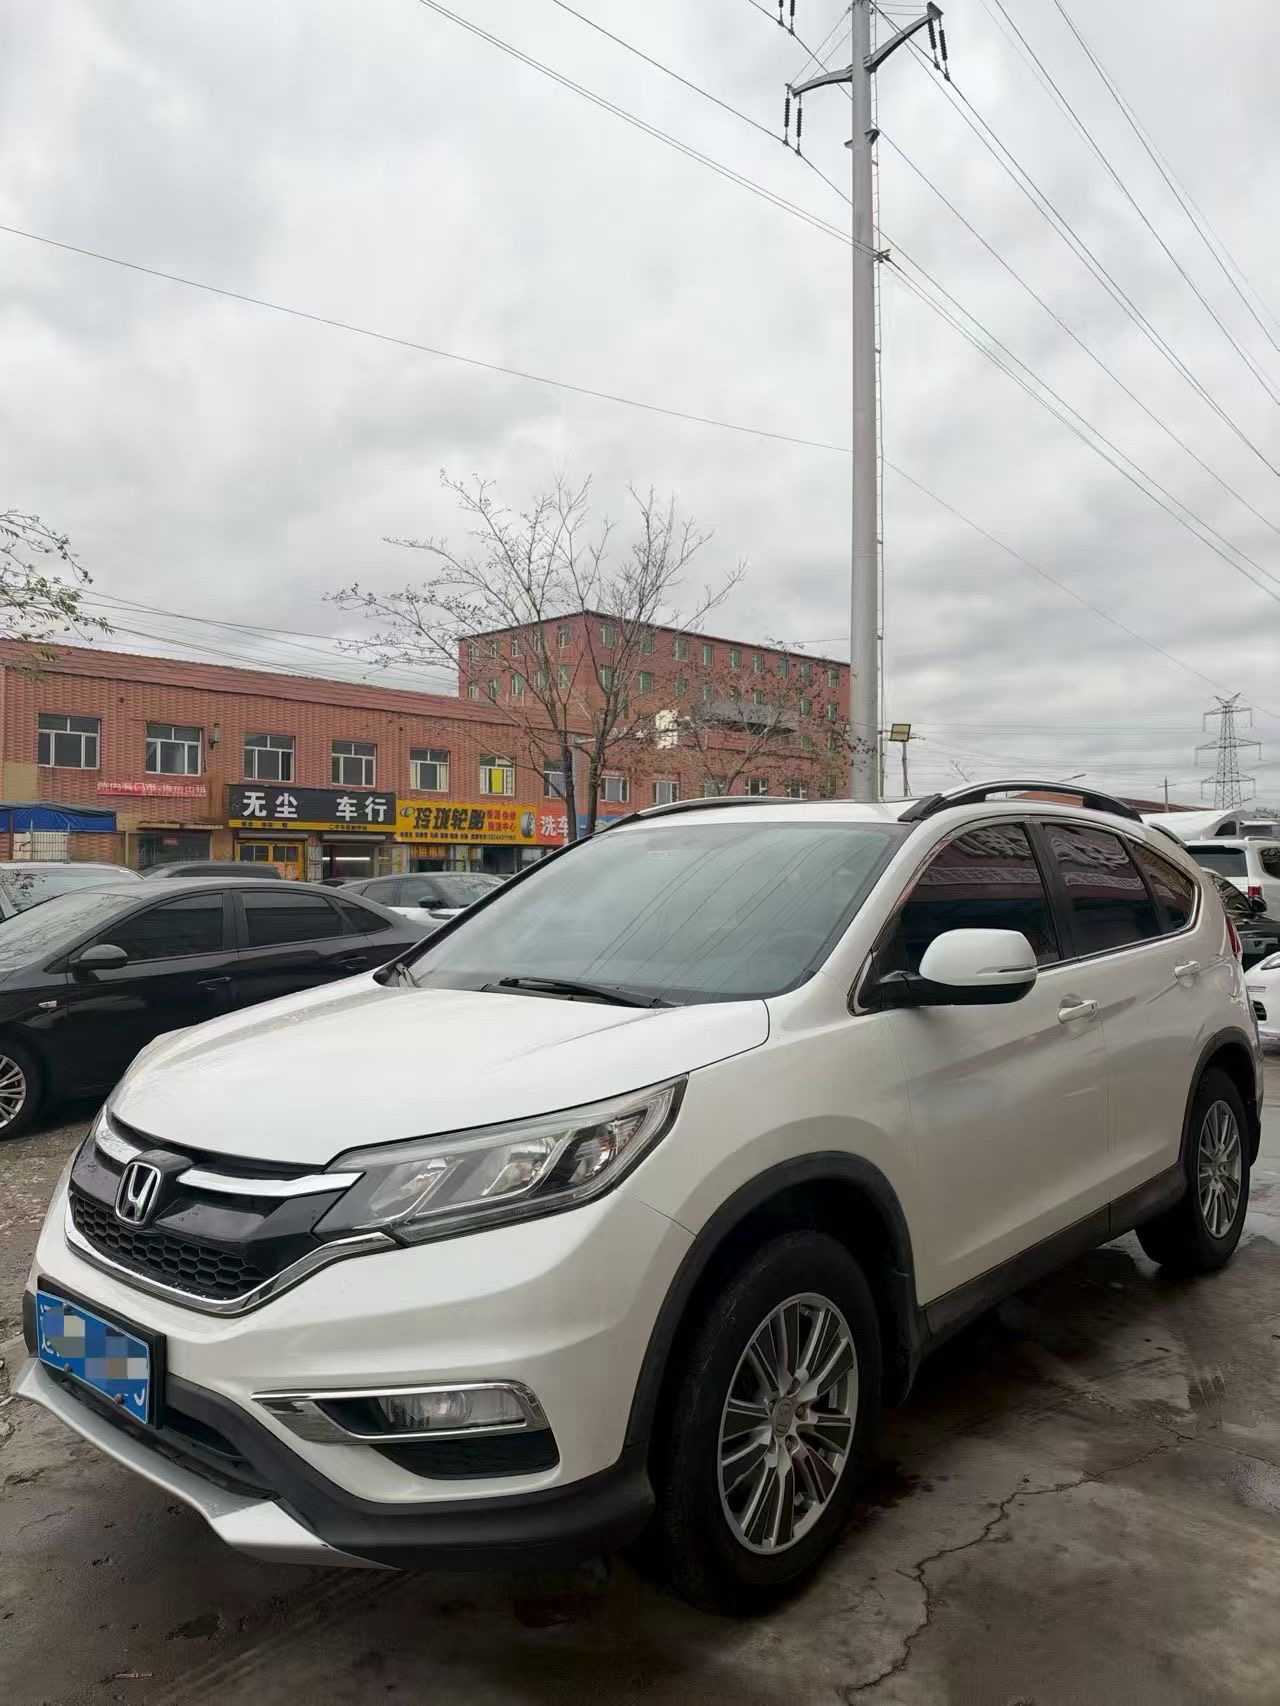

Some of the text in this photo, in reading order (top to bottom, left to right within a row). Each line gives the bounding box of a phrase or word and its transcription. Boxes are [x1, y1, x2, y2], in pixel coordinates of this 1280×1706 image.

[242, 791, 388, 822] 无尘 车行
[541, 815, 569, 837] 洗车
